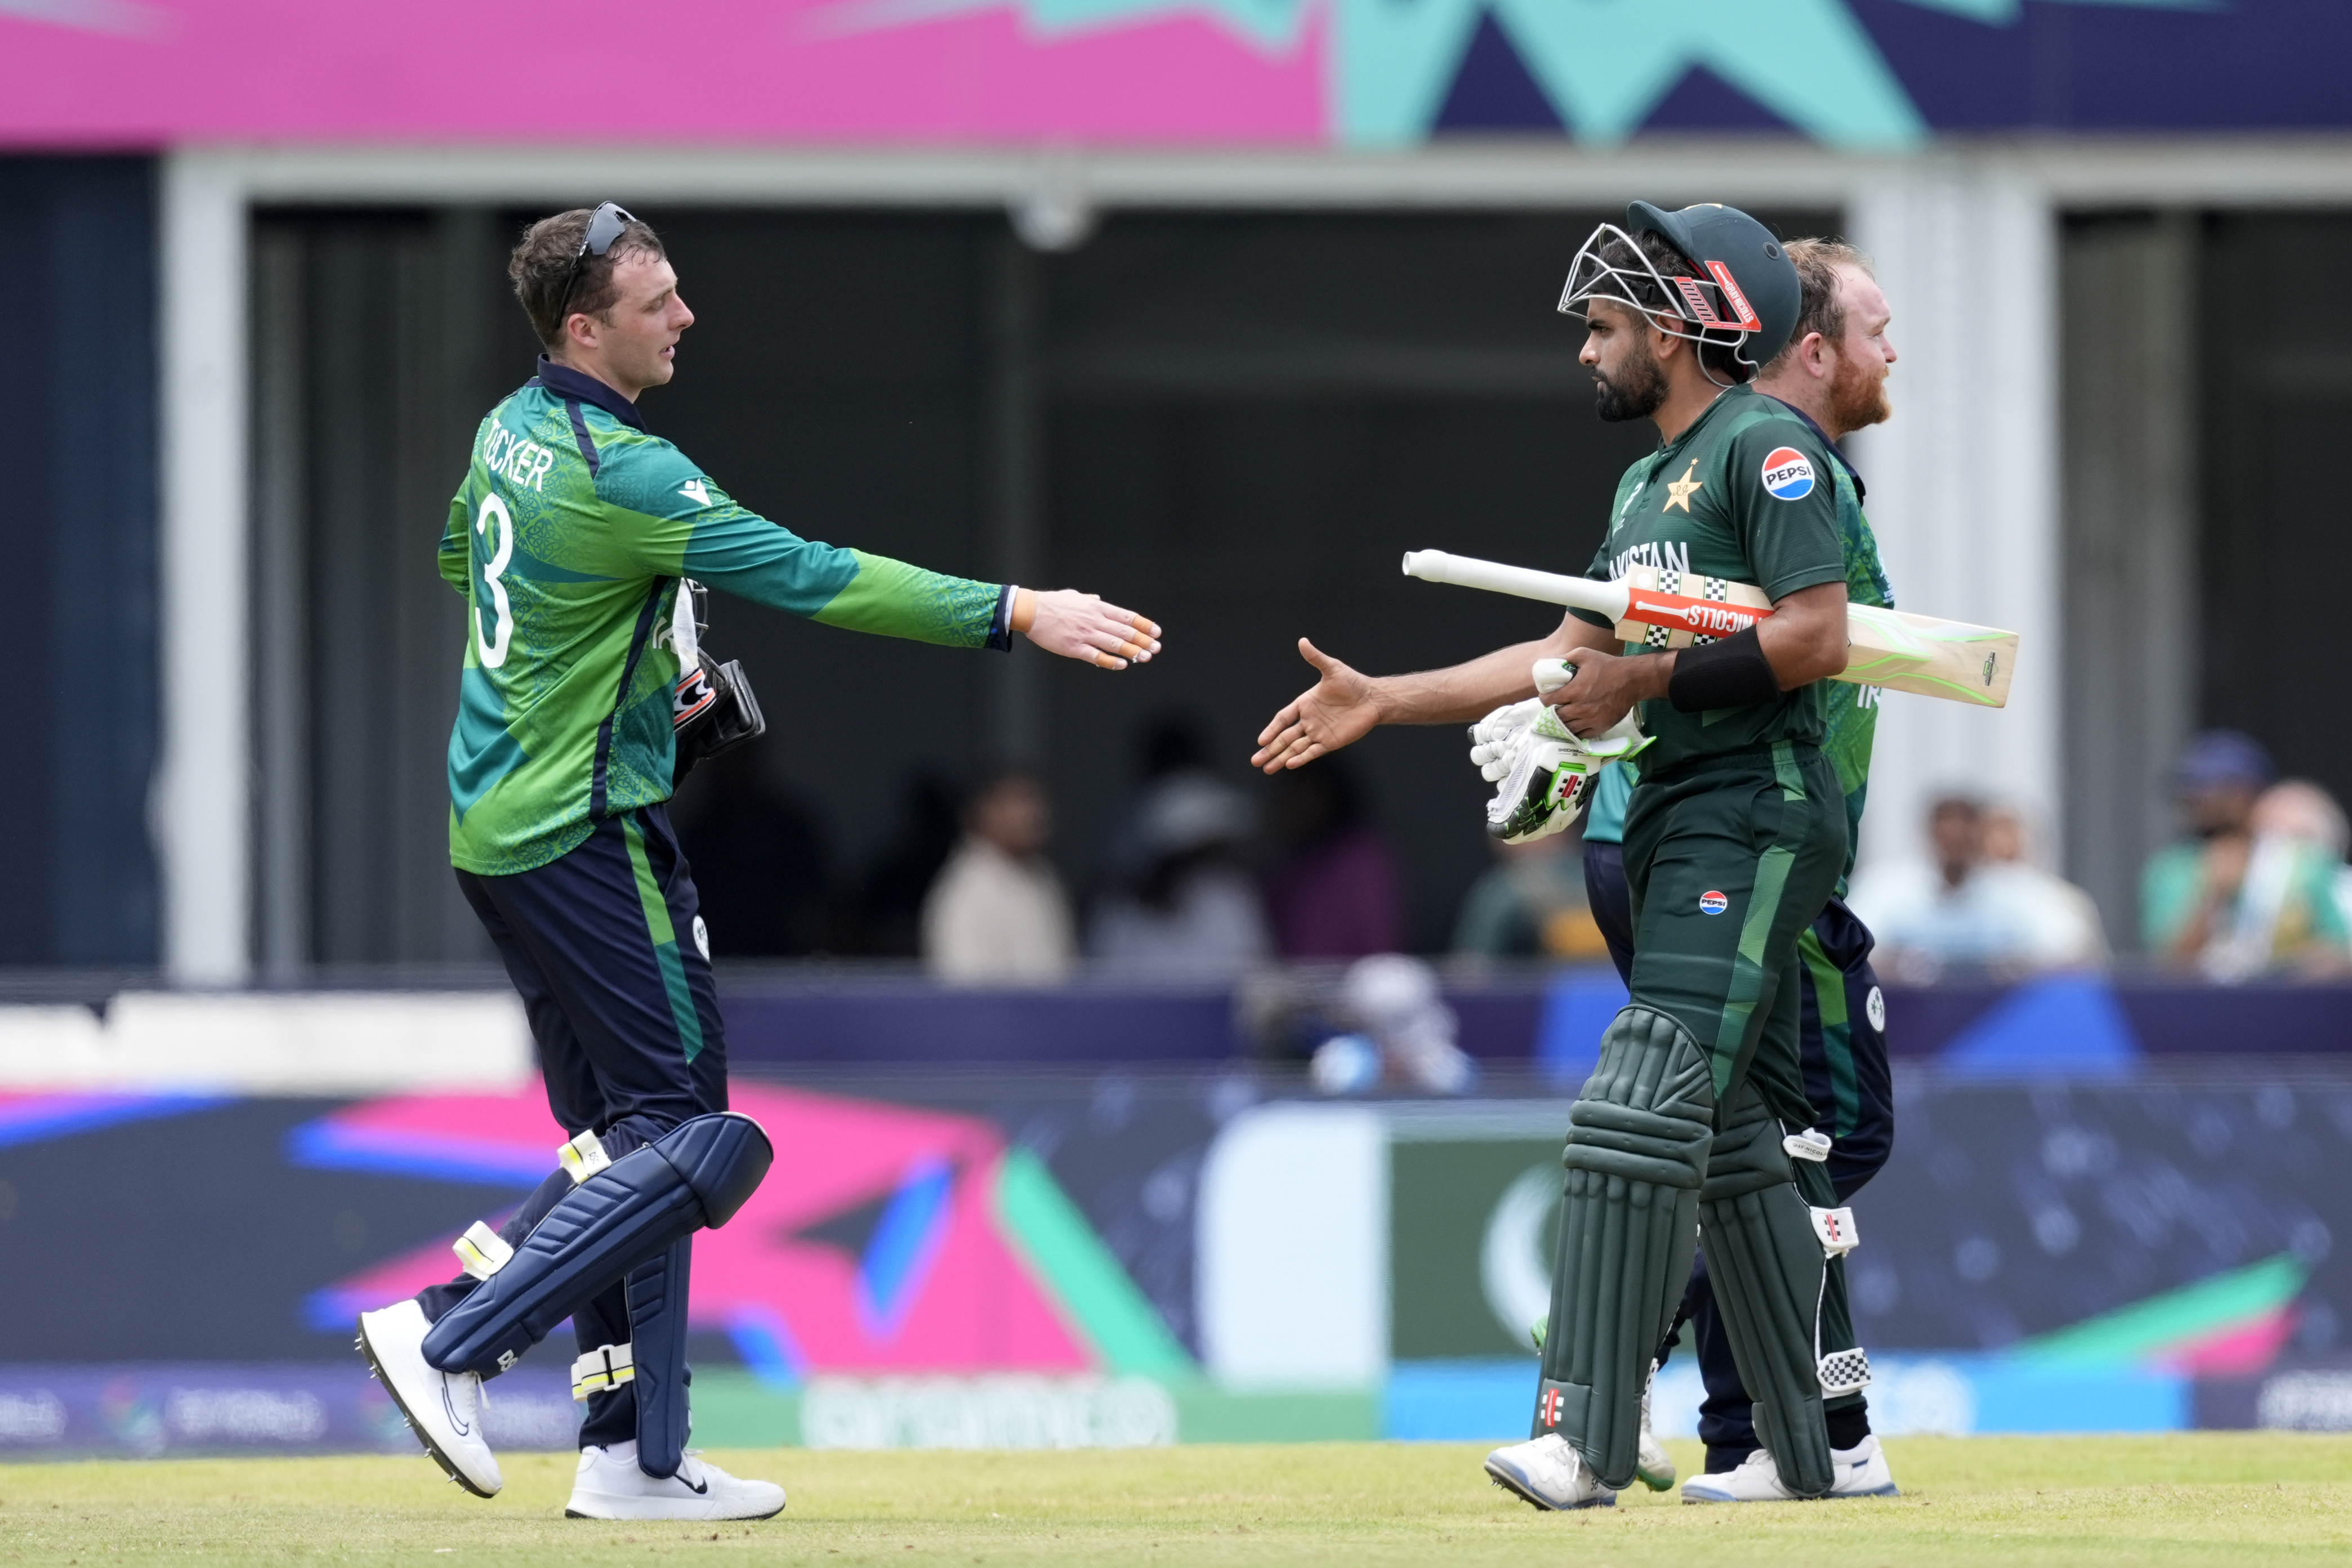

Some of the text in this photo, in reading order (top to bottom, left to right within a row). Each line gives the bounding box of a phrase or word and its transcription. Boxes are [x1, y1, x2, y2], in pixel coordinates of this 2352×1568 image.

[1766, 466, 1812, 486] PEPSI
[475, 492, 514, 668] 3
[1609, 541, 1690, 581] AKISTAN
